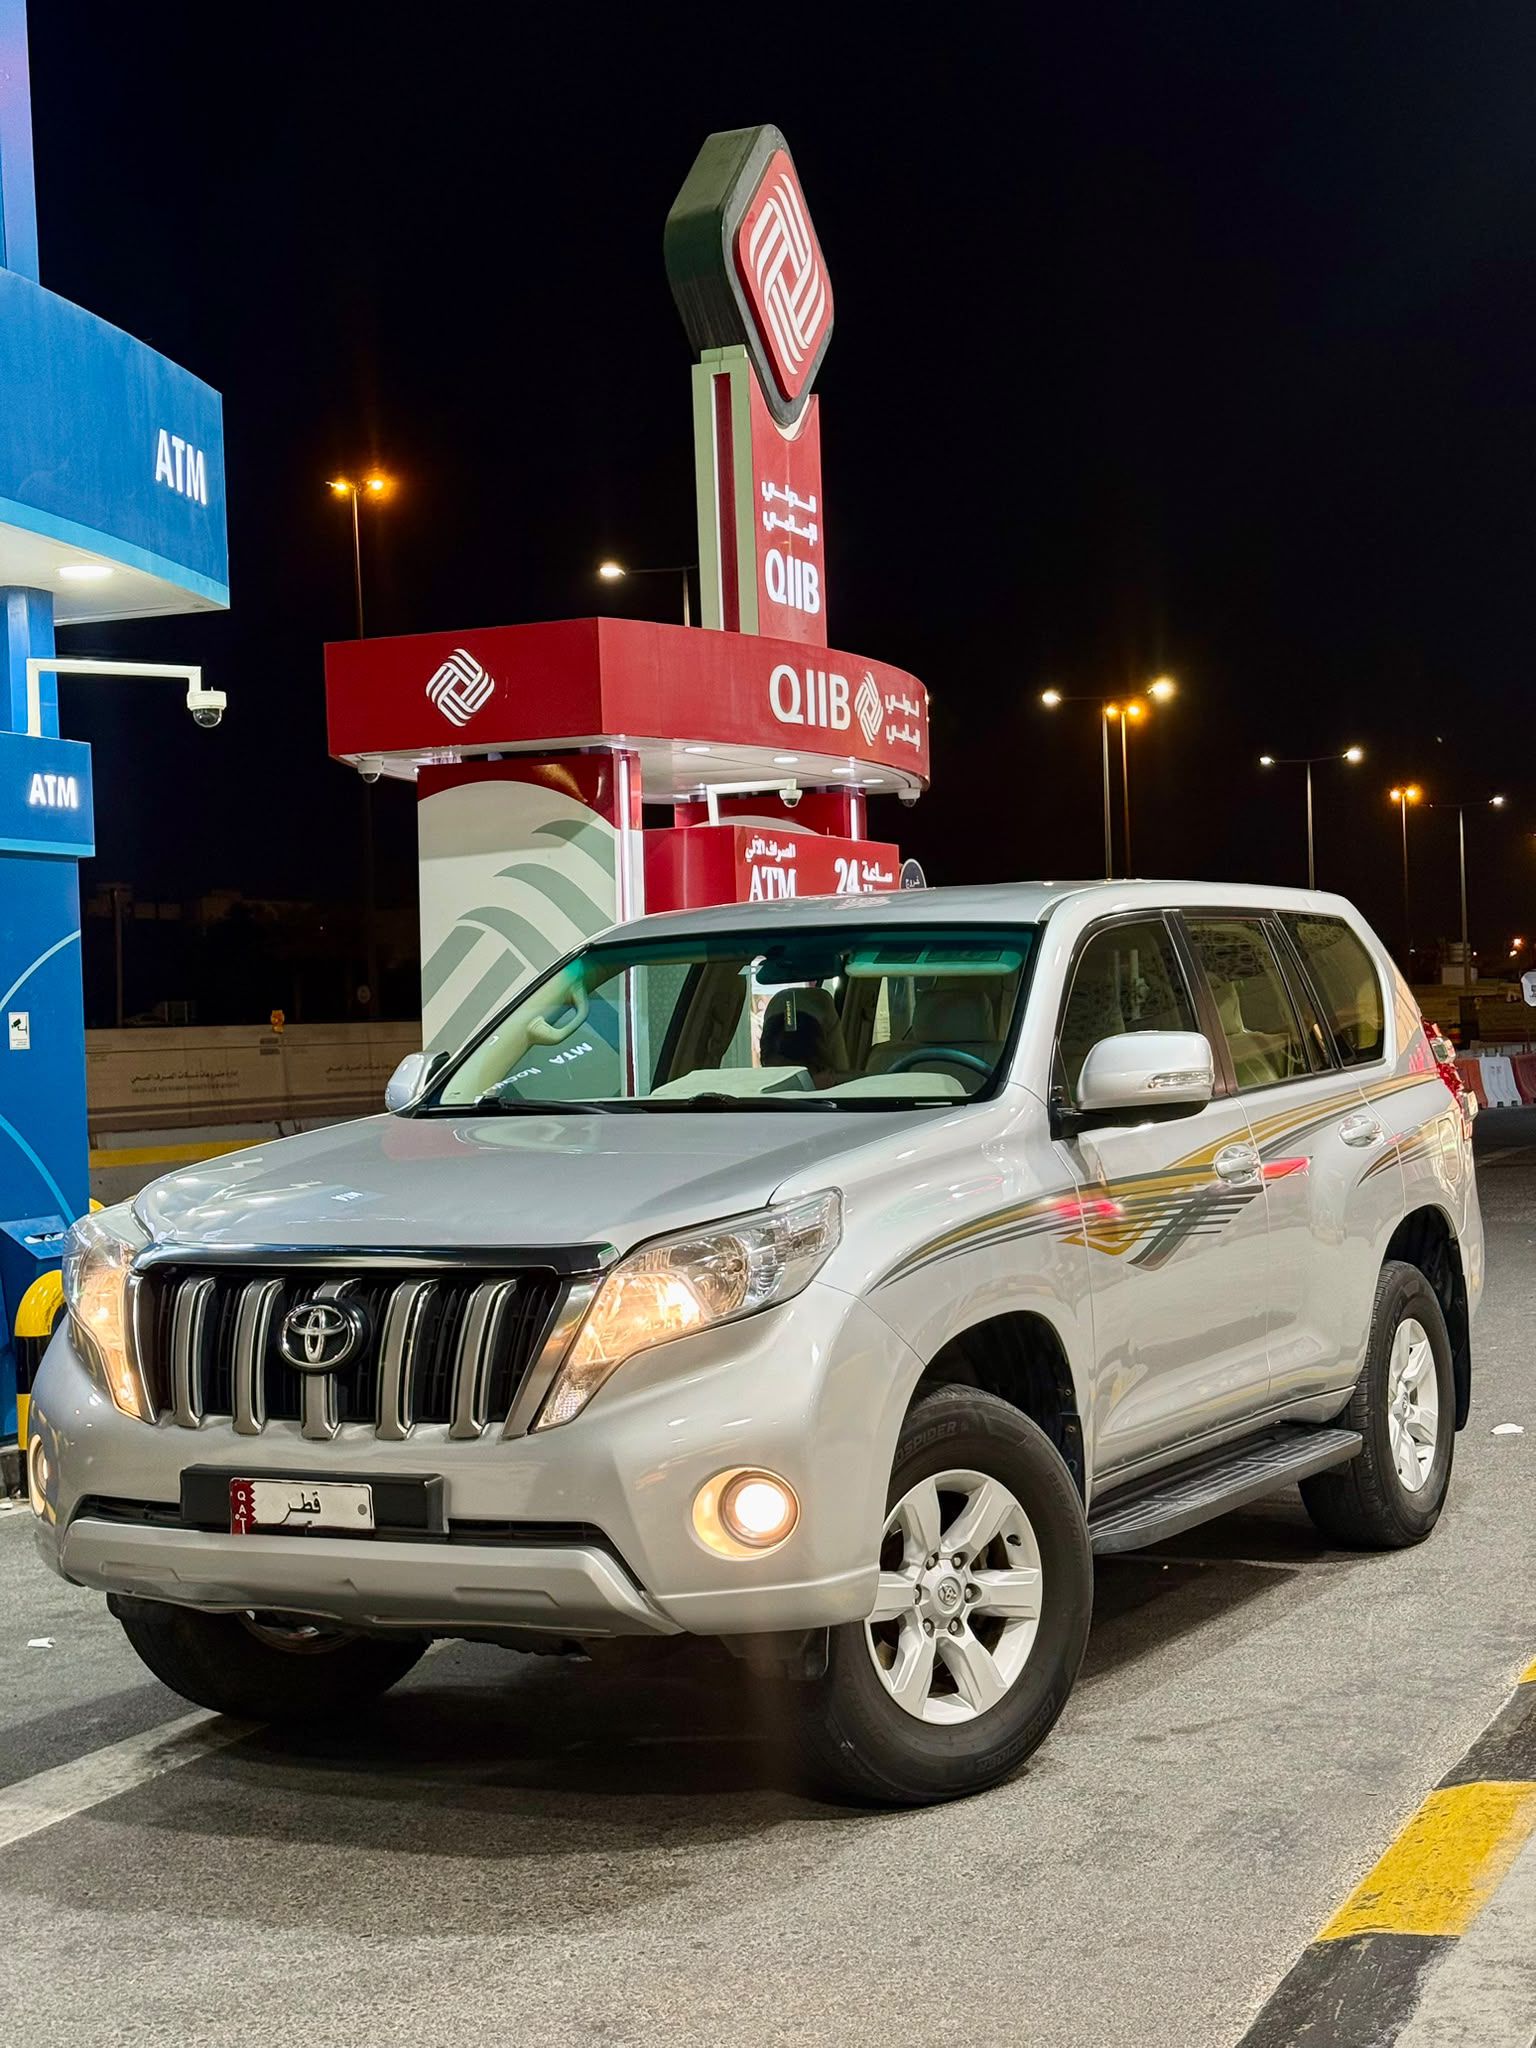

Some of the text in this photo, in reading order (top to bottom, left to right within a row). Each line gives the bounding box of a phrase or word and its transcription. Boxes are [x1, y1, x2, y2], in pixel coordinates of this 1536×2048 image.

[155, 427, 207, 506] ATM
[765, 548, 820, 614] QIIB
[769, 664, 851, 731] QIIB
[28, 774, 79, 809] ATM
[765, 840, 796, 863] الصراف
[748, 864, 797, 902] ATM
[834, 857, 893, 894] 24 ساعة
[280, 1490, 321, 1525] قطر
